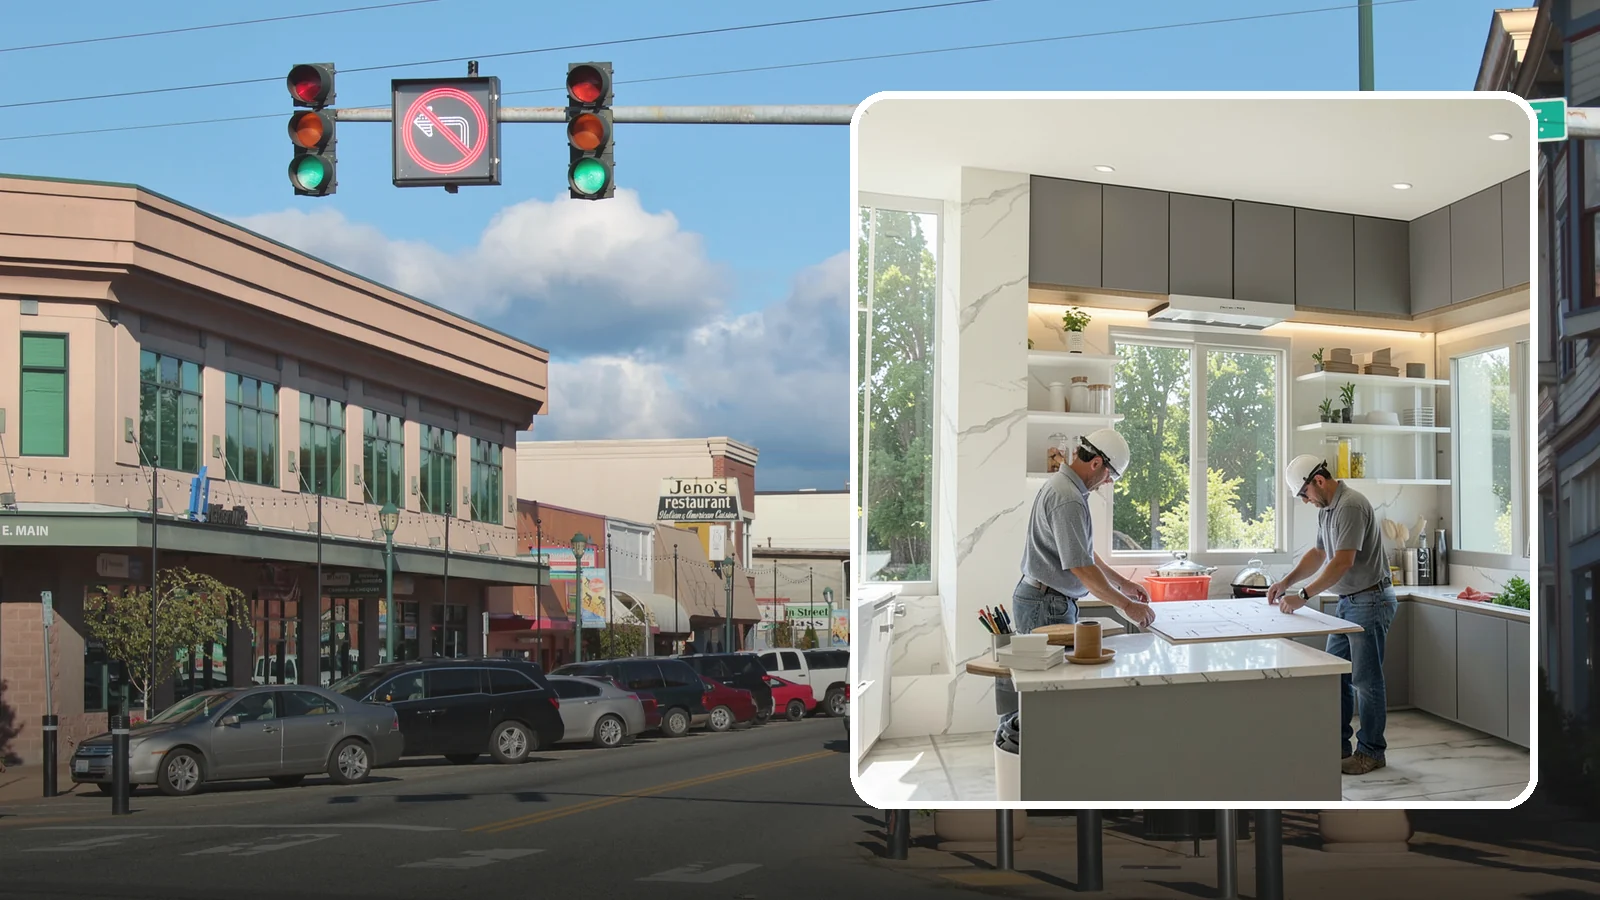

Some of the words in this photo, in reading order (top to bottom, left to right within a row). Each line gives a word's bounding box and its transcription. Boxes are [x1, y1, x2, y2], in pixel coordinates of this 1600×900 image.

[670, 480, 728, 494] Jeno's
[665, 496, 731, 509] restaurant
[659, 510, 682, 520] Italian
[686, 510, 714, 520] American
[715, 509, 738, 520] Cuisine
[2, 525, 13, 536] E.
[15, 525, 49, 536] MAIN
[797, 607, 828, 616] Street
[791, 619, 824, 627] lass
